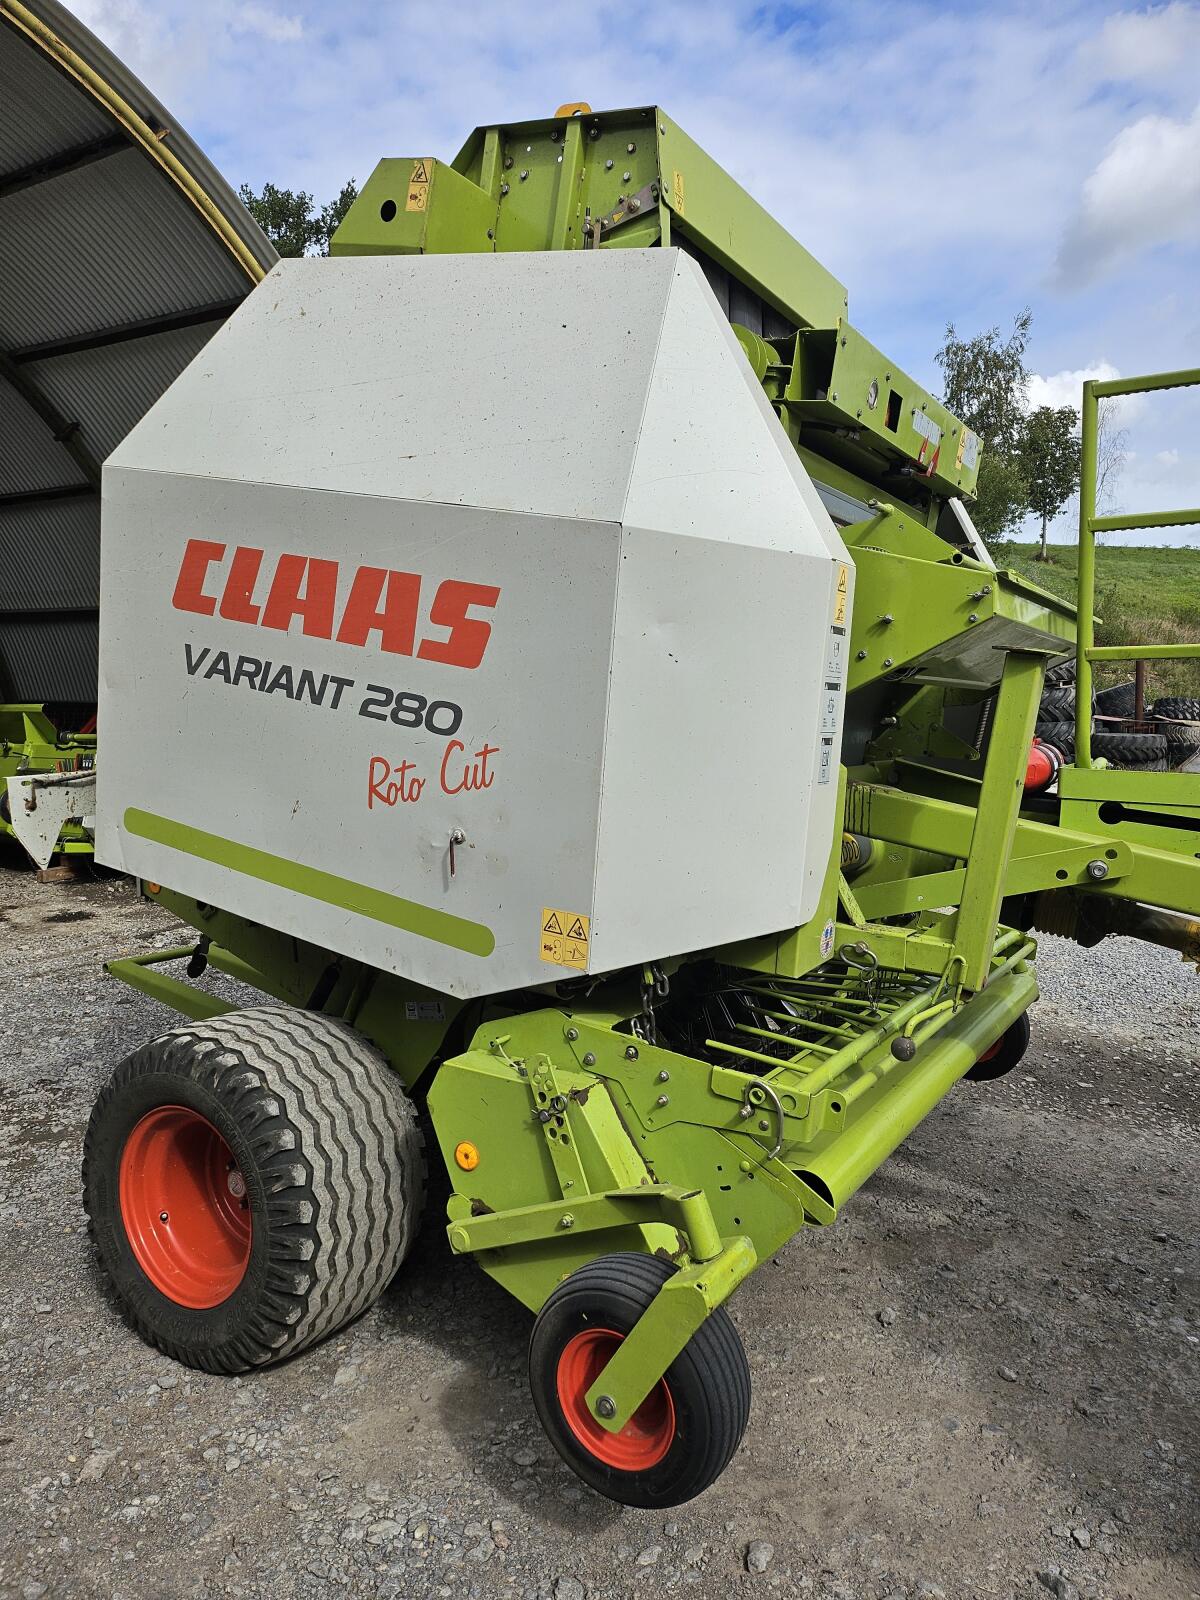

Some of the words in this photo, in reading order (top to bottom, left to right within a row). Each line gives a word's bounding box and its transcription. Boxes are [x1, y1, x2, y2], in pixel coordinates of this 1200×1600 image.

[172, 538, 501, 669] CLAAS
[184, 643, 354, 709] VARIANT
[358, 683, 463, 737] 280
[368, 756, 425, 809] Roto
[440, 739, 499, 794] Cut
